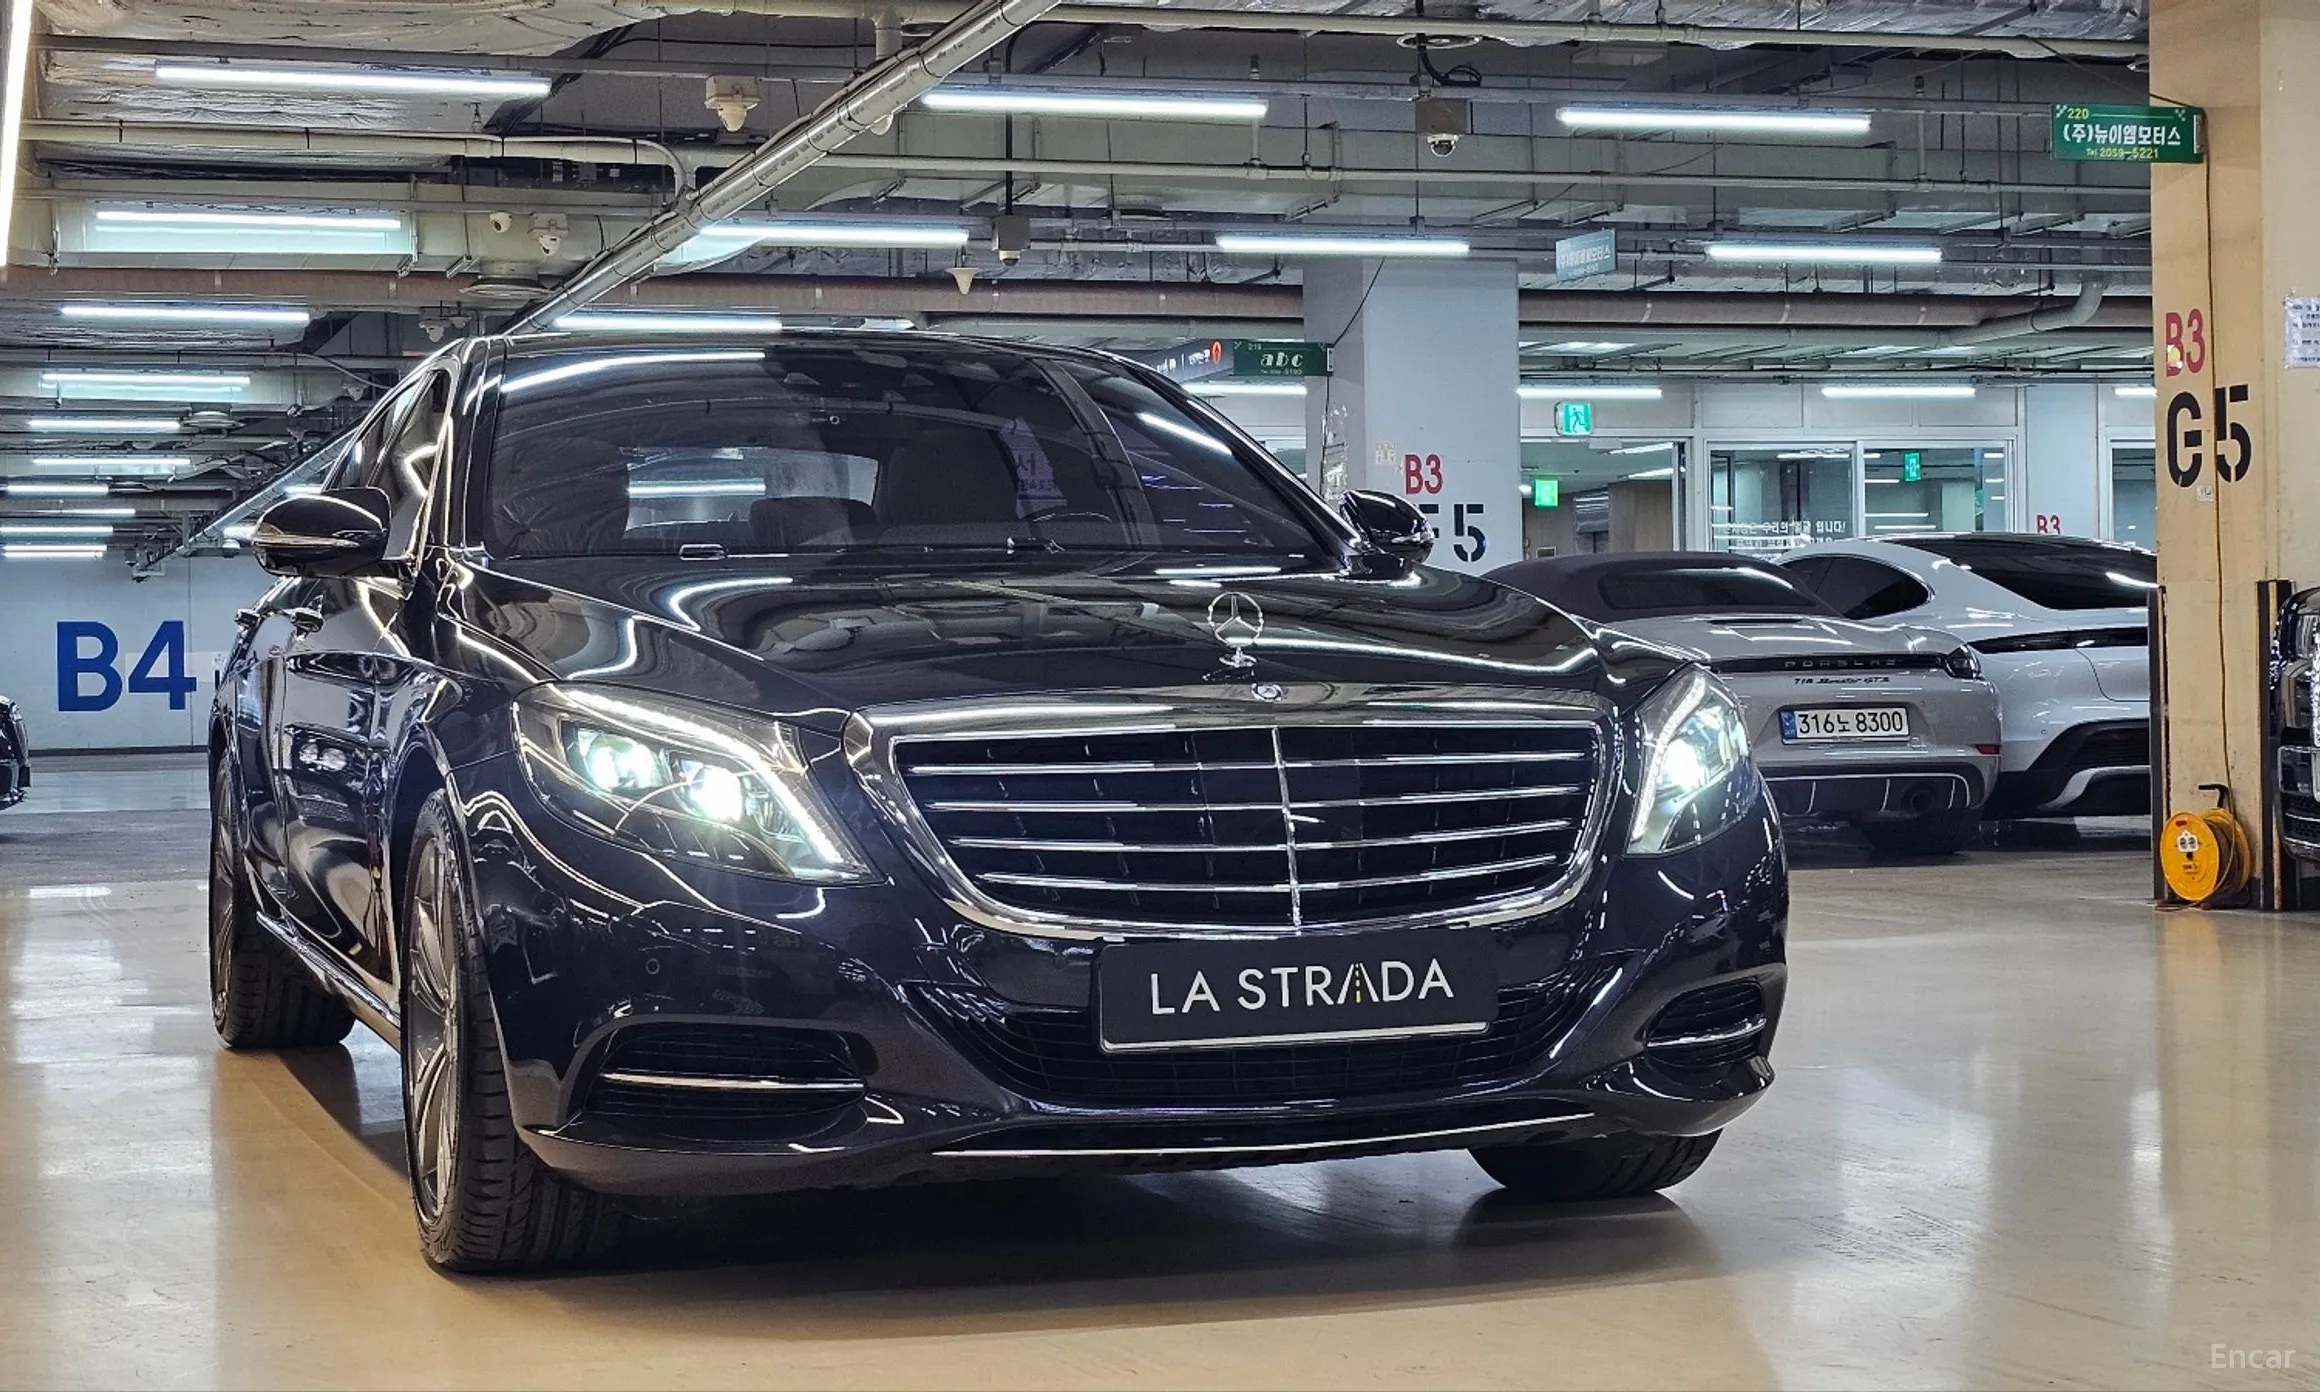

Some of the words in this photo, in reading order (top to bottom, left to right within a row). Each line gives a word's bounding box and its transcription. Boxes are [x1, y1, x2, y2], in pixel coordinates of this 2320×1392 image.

[2067, 108, 2089, 119] 220
[2166, 308, 2206, 377] B3
[1260, 352, 1303, 367] abc
[1405, 454, 1442, 494] B3
[1816, 520, 1846, 533] 입니다!
[56, 620, 197, 712] B4
[1798, 713, 1850, 734] 316노
[1855, 711, 1903, 733] 8300
[1150, 970, 1220, 1015] LA
[1237, 957, 1454, 1011] STRADA
